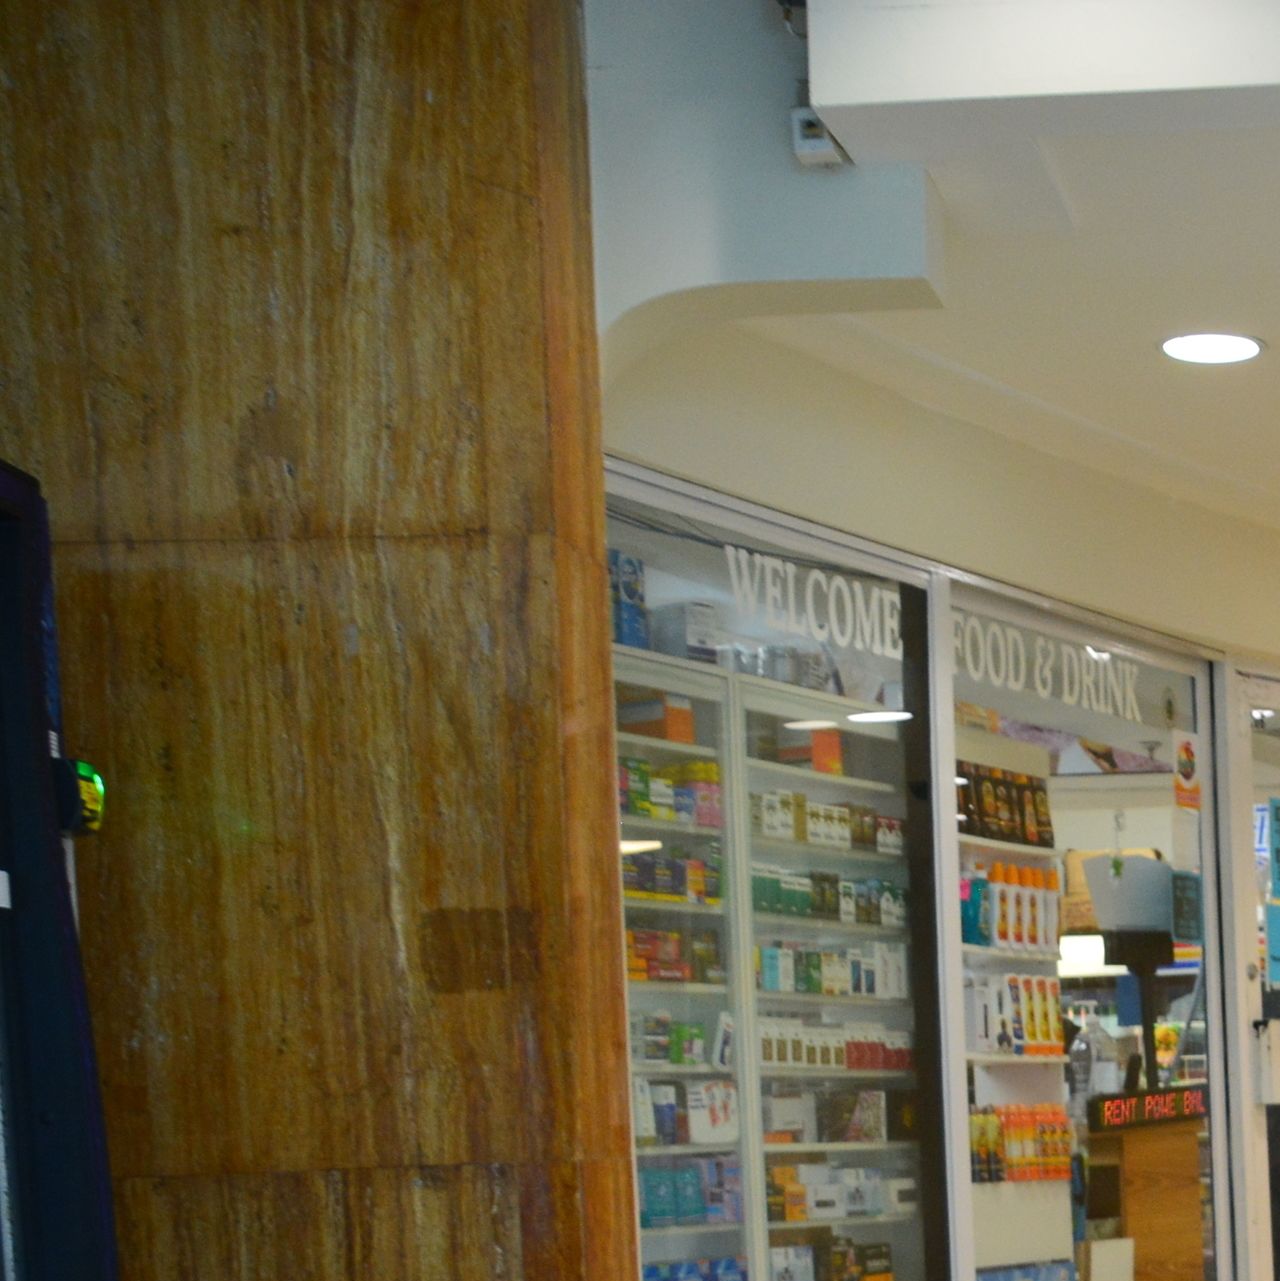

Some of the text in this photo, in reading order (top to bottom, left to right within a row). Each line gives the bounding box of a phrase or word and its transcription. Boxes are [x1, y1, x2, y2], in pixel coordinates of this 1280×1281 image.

[724, 544, 903, 661] WELCOME
[950, 612, 1142, 723] FOOD & DRINK
[1103, 1098, 1138, 1125] RENT
